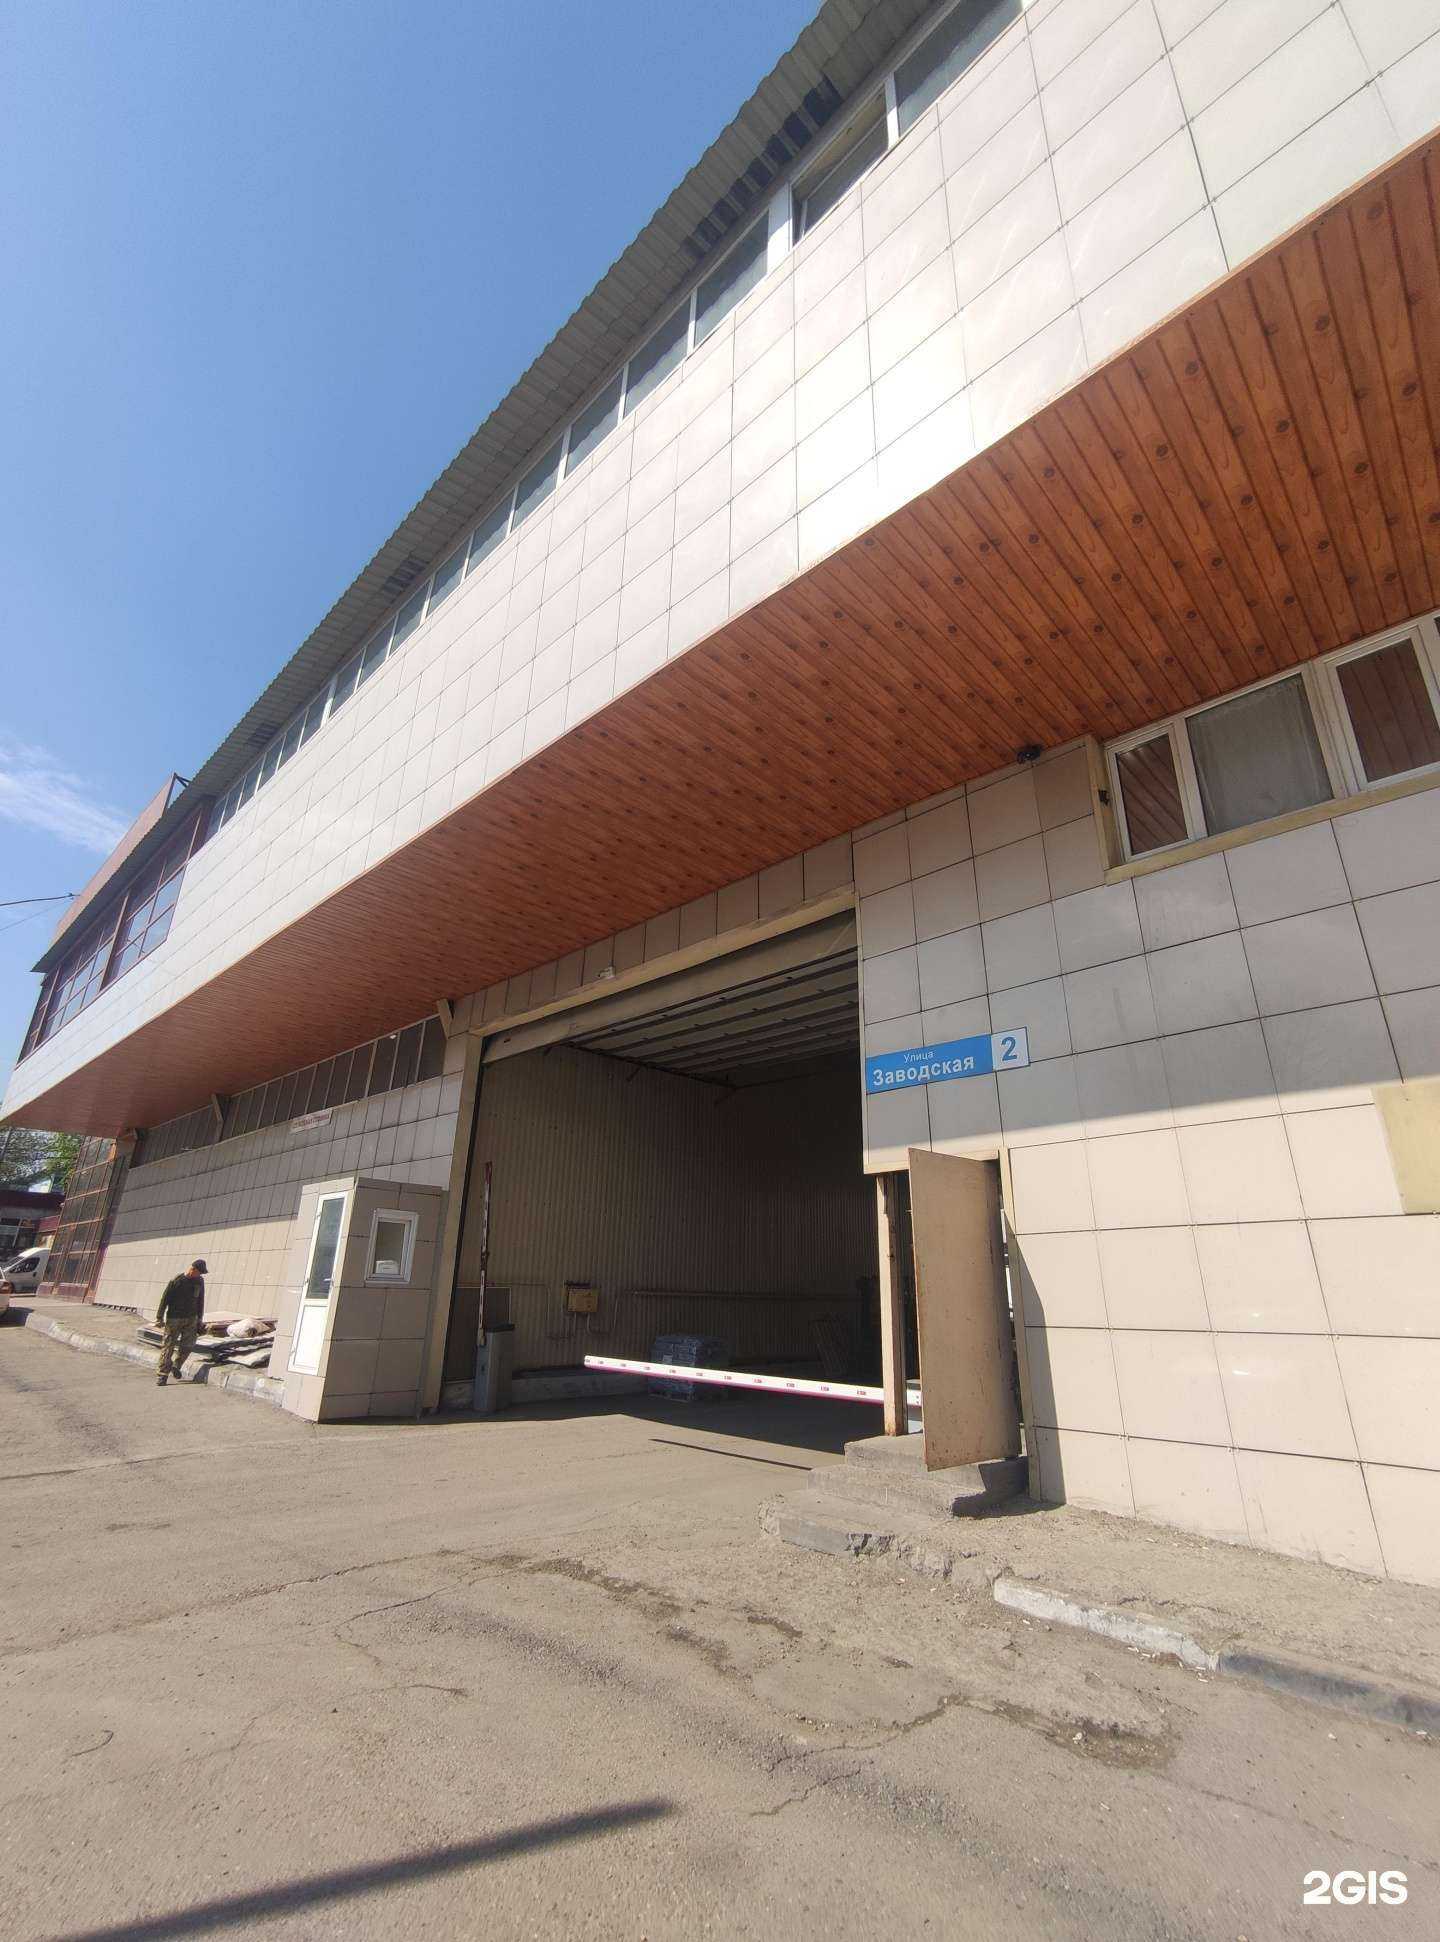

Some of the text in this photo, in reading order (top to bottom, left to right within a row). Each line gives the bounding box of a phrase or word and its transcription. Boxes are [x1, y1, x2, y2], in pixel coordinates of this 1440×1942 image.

[903, 1050, 935, 1063] Улица
[1001, 1036, 1018, 1062] 2
[873, 1055, 975, 1086] Заводская
